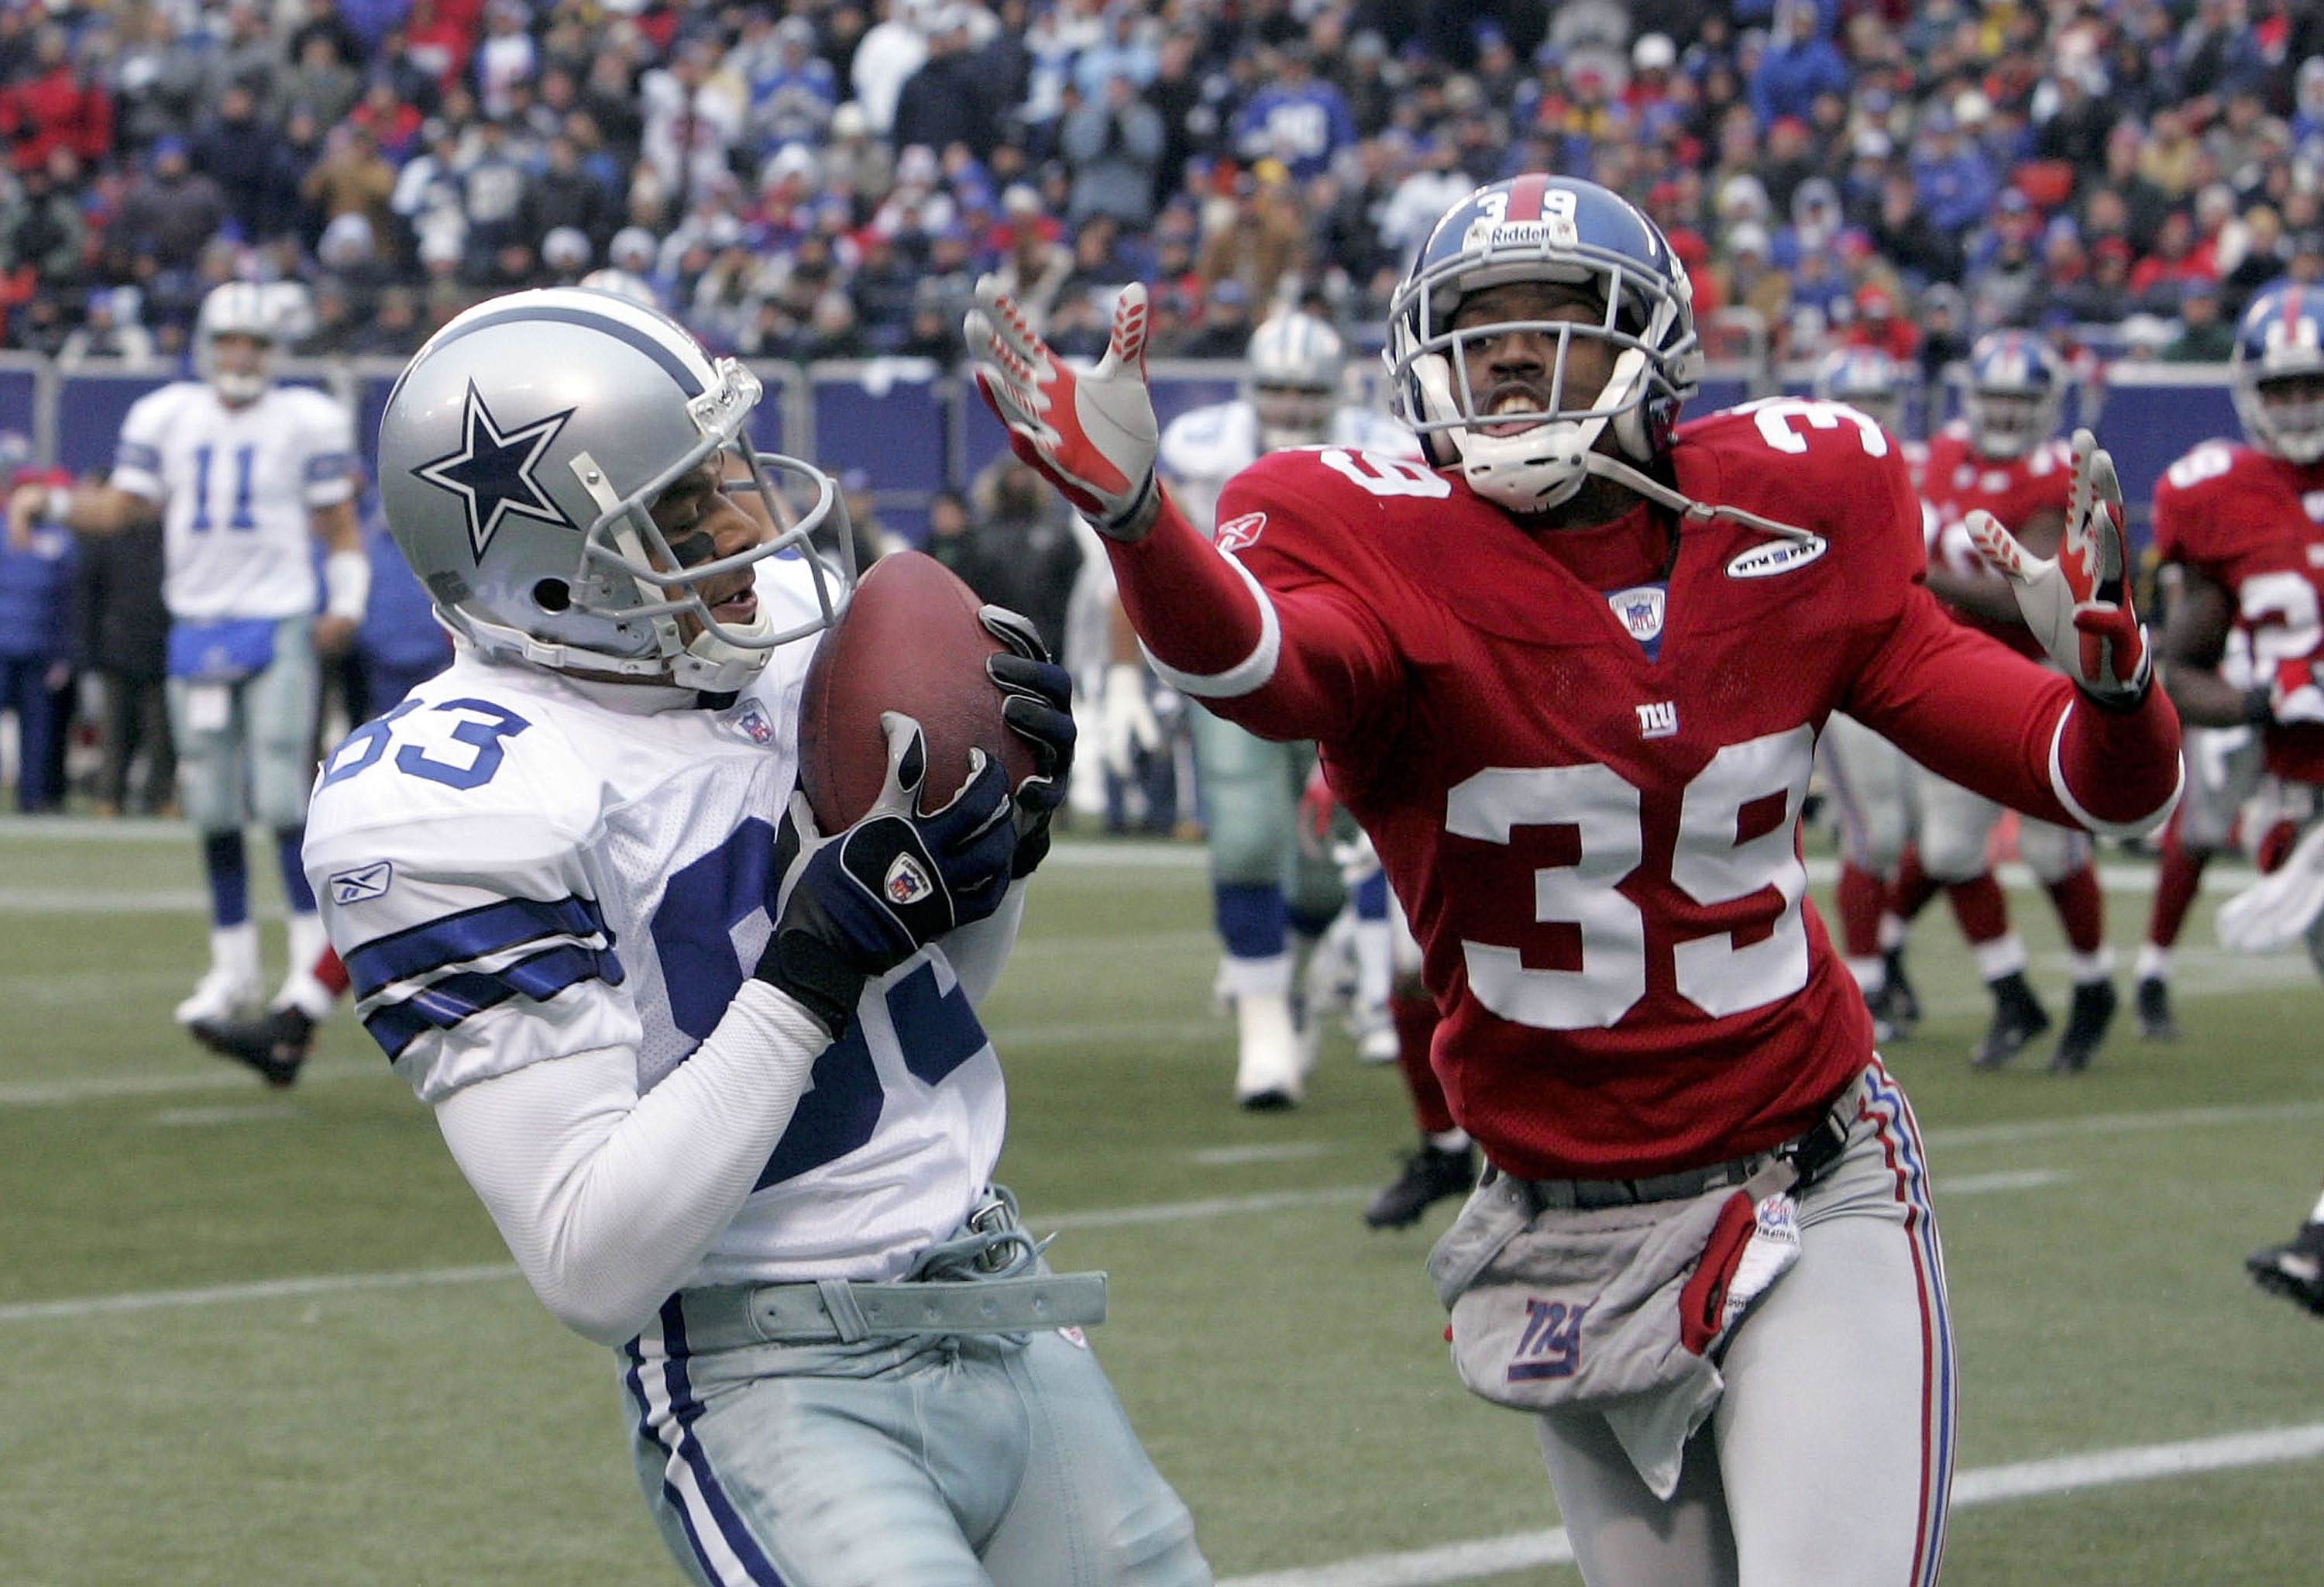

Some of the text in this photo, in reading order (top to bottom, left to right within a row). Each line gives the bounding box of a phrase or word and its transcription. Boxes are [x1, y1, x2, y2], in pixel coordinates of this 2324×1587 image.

[1492, 226, 1549, 243] Riddell
[191, 444, 257, 531] 11
[314, 697, 533, 791] 83
[1446, 721, 1815, 1031] 39
